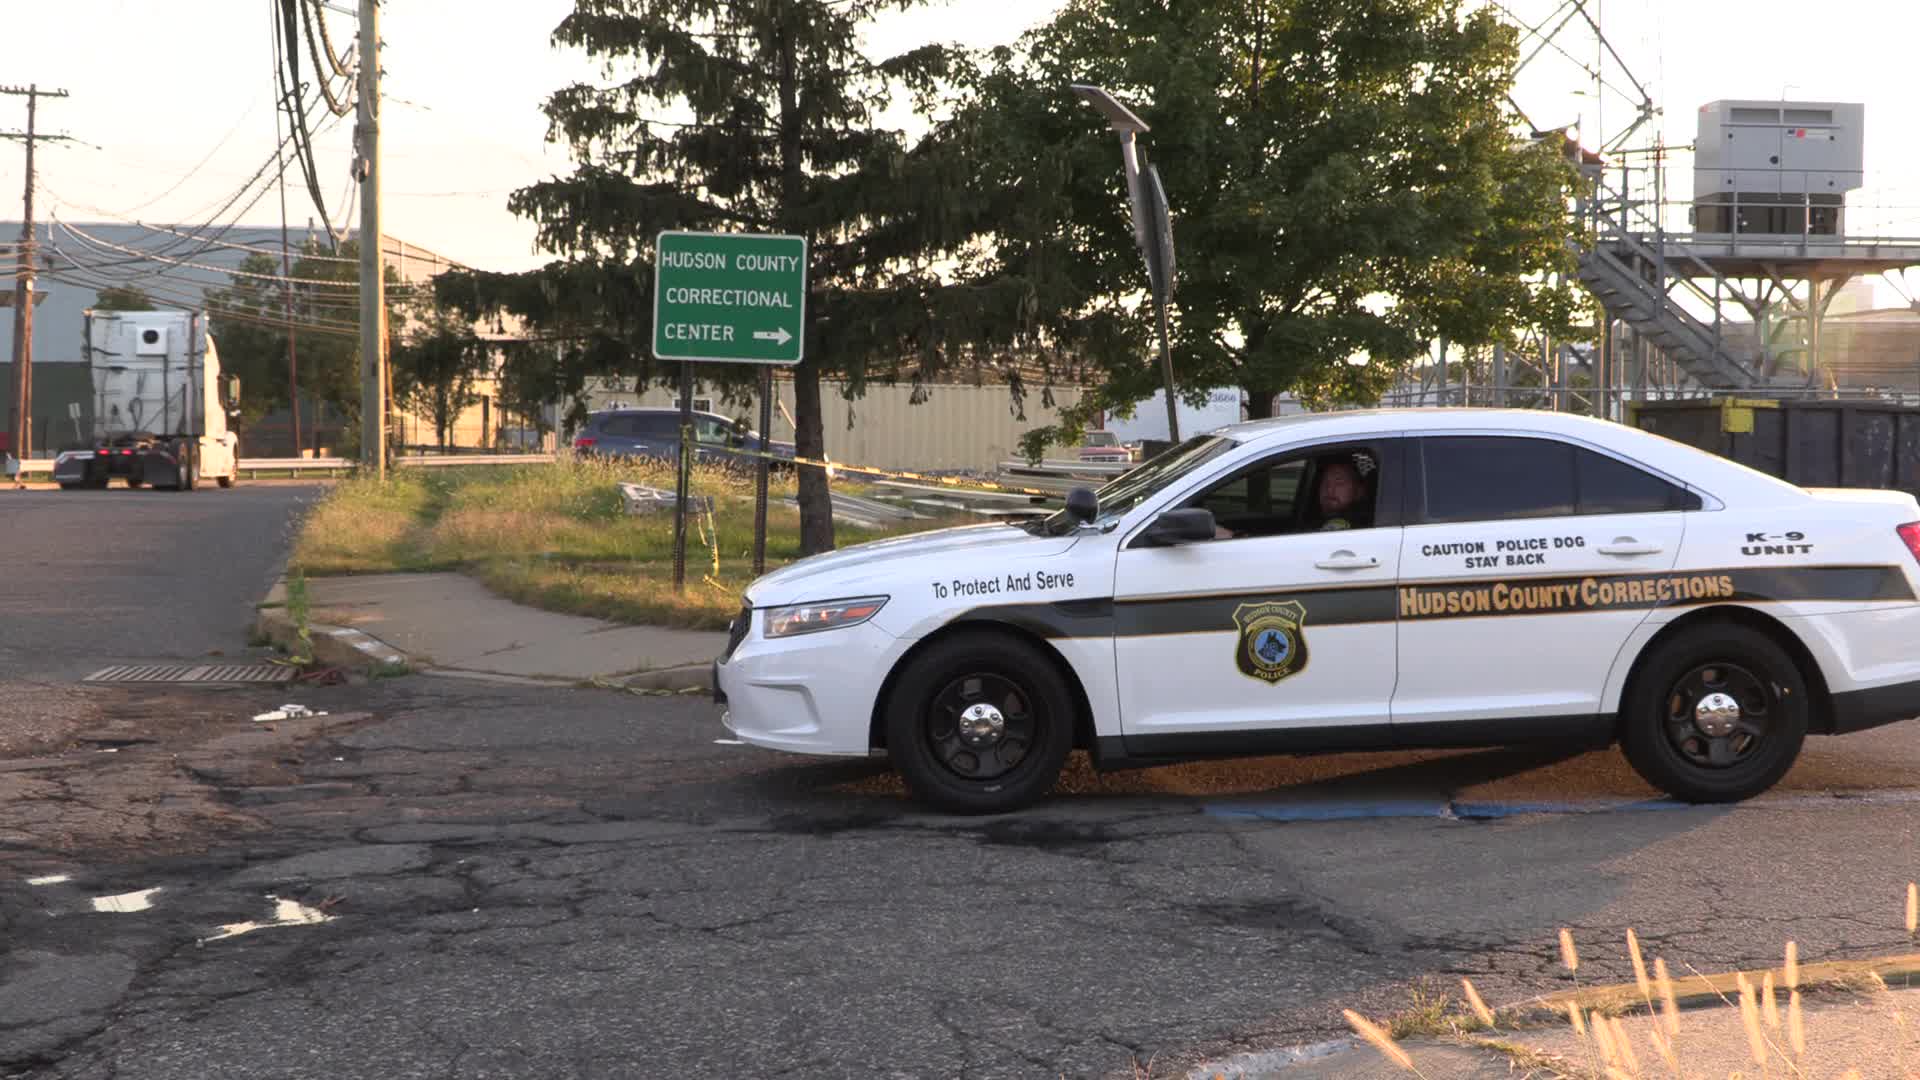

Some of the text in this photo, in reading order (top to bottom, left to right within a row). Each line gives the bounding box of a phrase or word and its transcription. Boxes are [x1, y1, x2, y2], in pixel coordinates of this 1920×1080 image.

[662, 251, 799, 272] HUDSON COUNTY
[666, 287, 793, 308] CORRECTIONAL
[664, 323, 734, 341] CENTER
[1745, 531, 1805, 543] K-9
[1422, 536, 1585, 557] CAUTION POLICE DOG
[1741, 544, 1814, 556] UNIT
[1465, 553, 1545, 569] STAY BACK
[932, 571, 1075, 599] To Protect And Serve
[1253, 667, 1291, 679] POLICE
